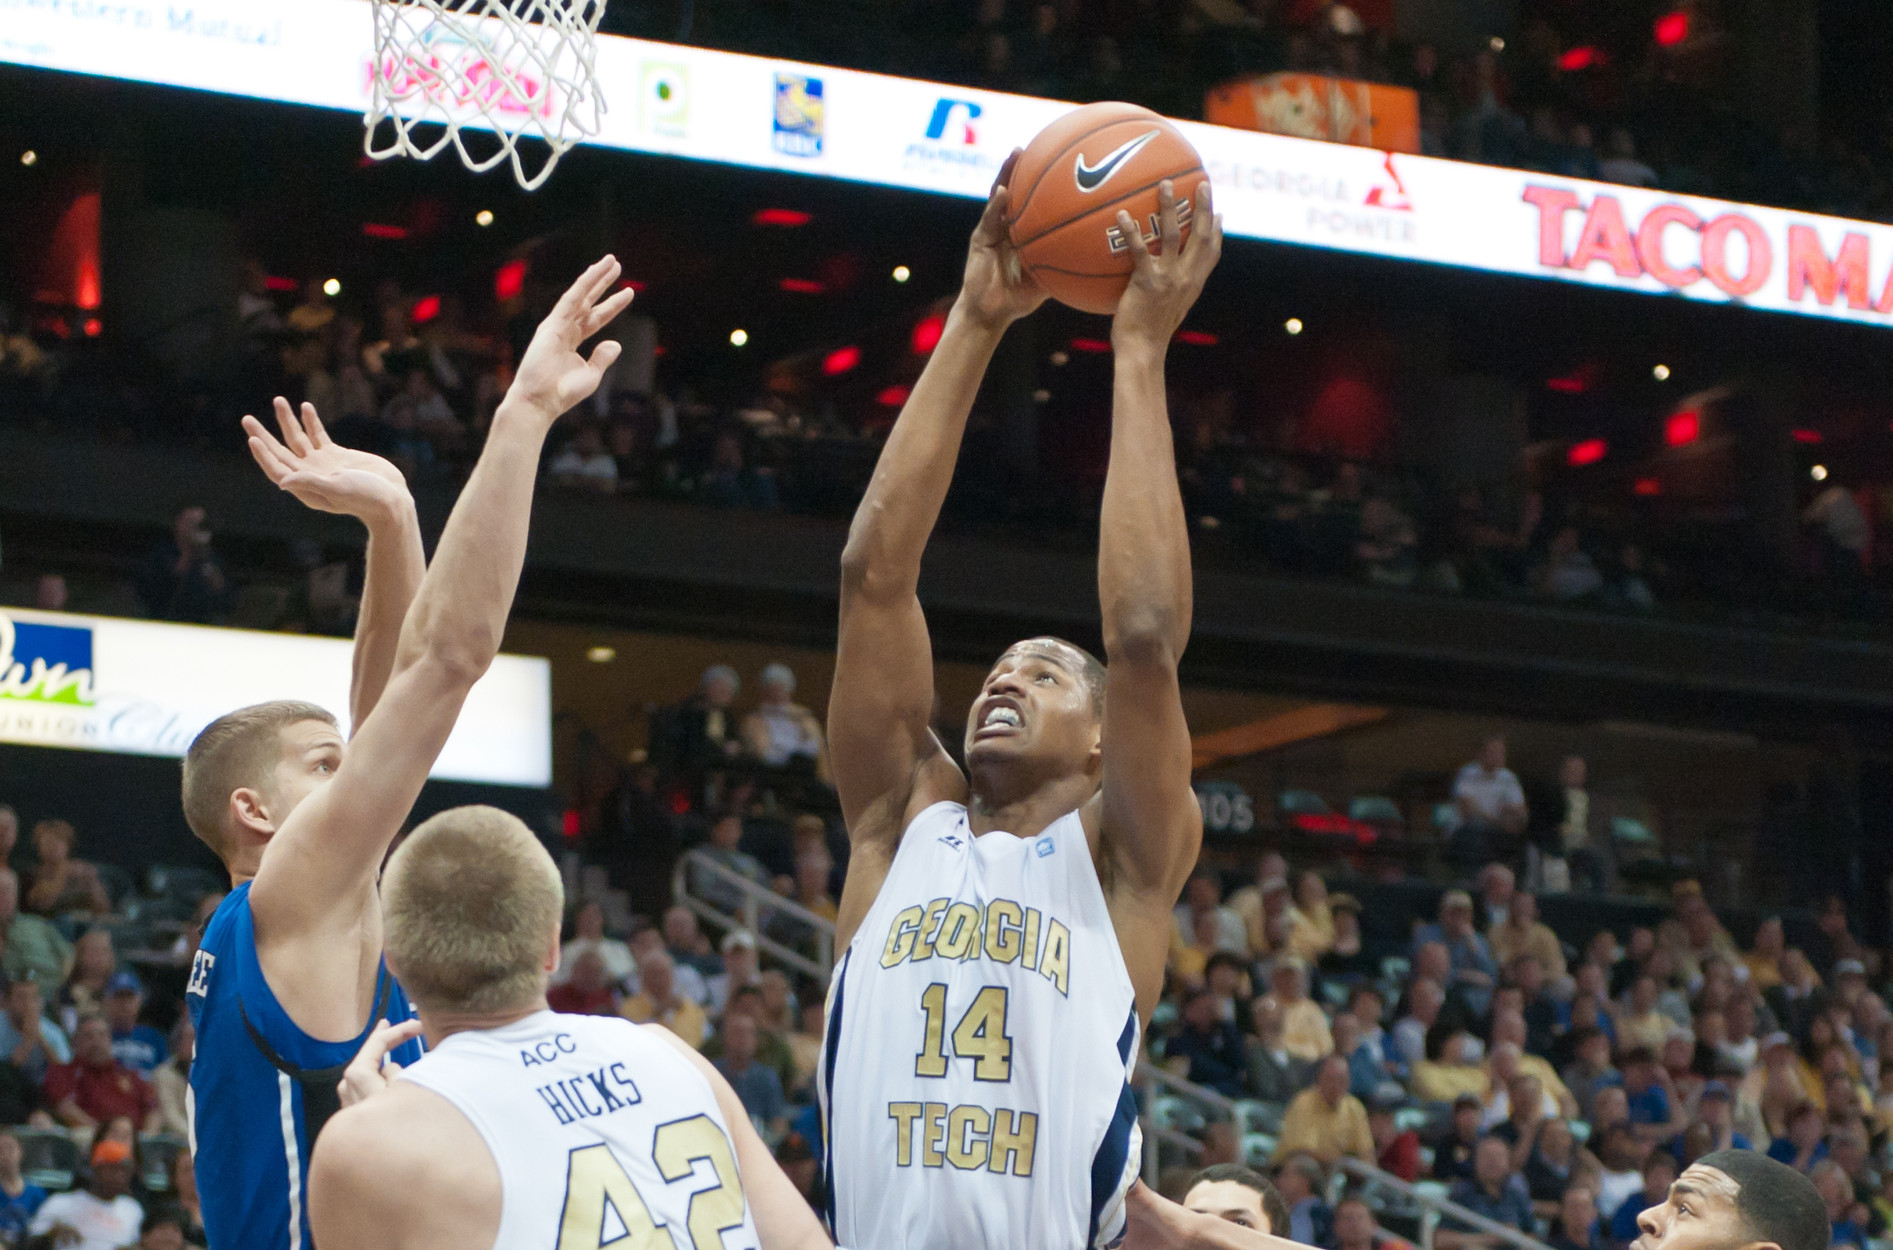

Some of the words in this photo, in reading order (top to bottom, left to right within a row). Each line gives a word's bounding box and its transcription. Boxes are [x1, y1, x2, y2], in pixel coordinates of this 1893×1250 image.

[1305, 206, 1419, 244] POWER
[1522, 184, 1772, 298] TACO
[520, 1033, 577, 1068] ACC
[914, 982, 1013, 1084] 14
[536, 1062, 642, 1125] HICKS
[888, 1101, 1040, 1178] TECH
